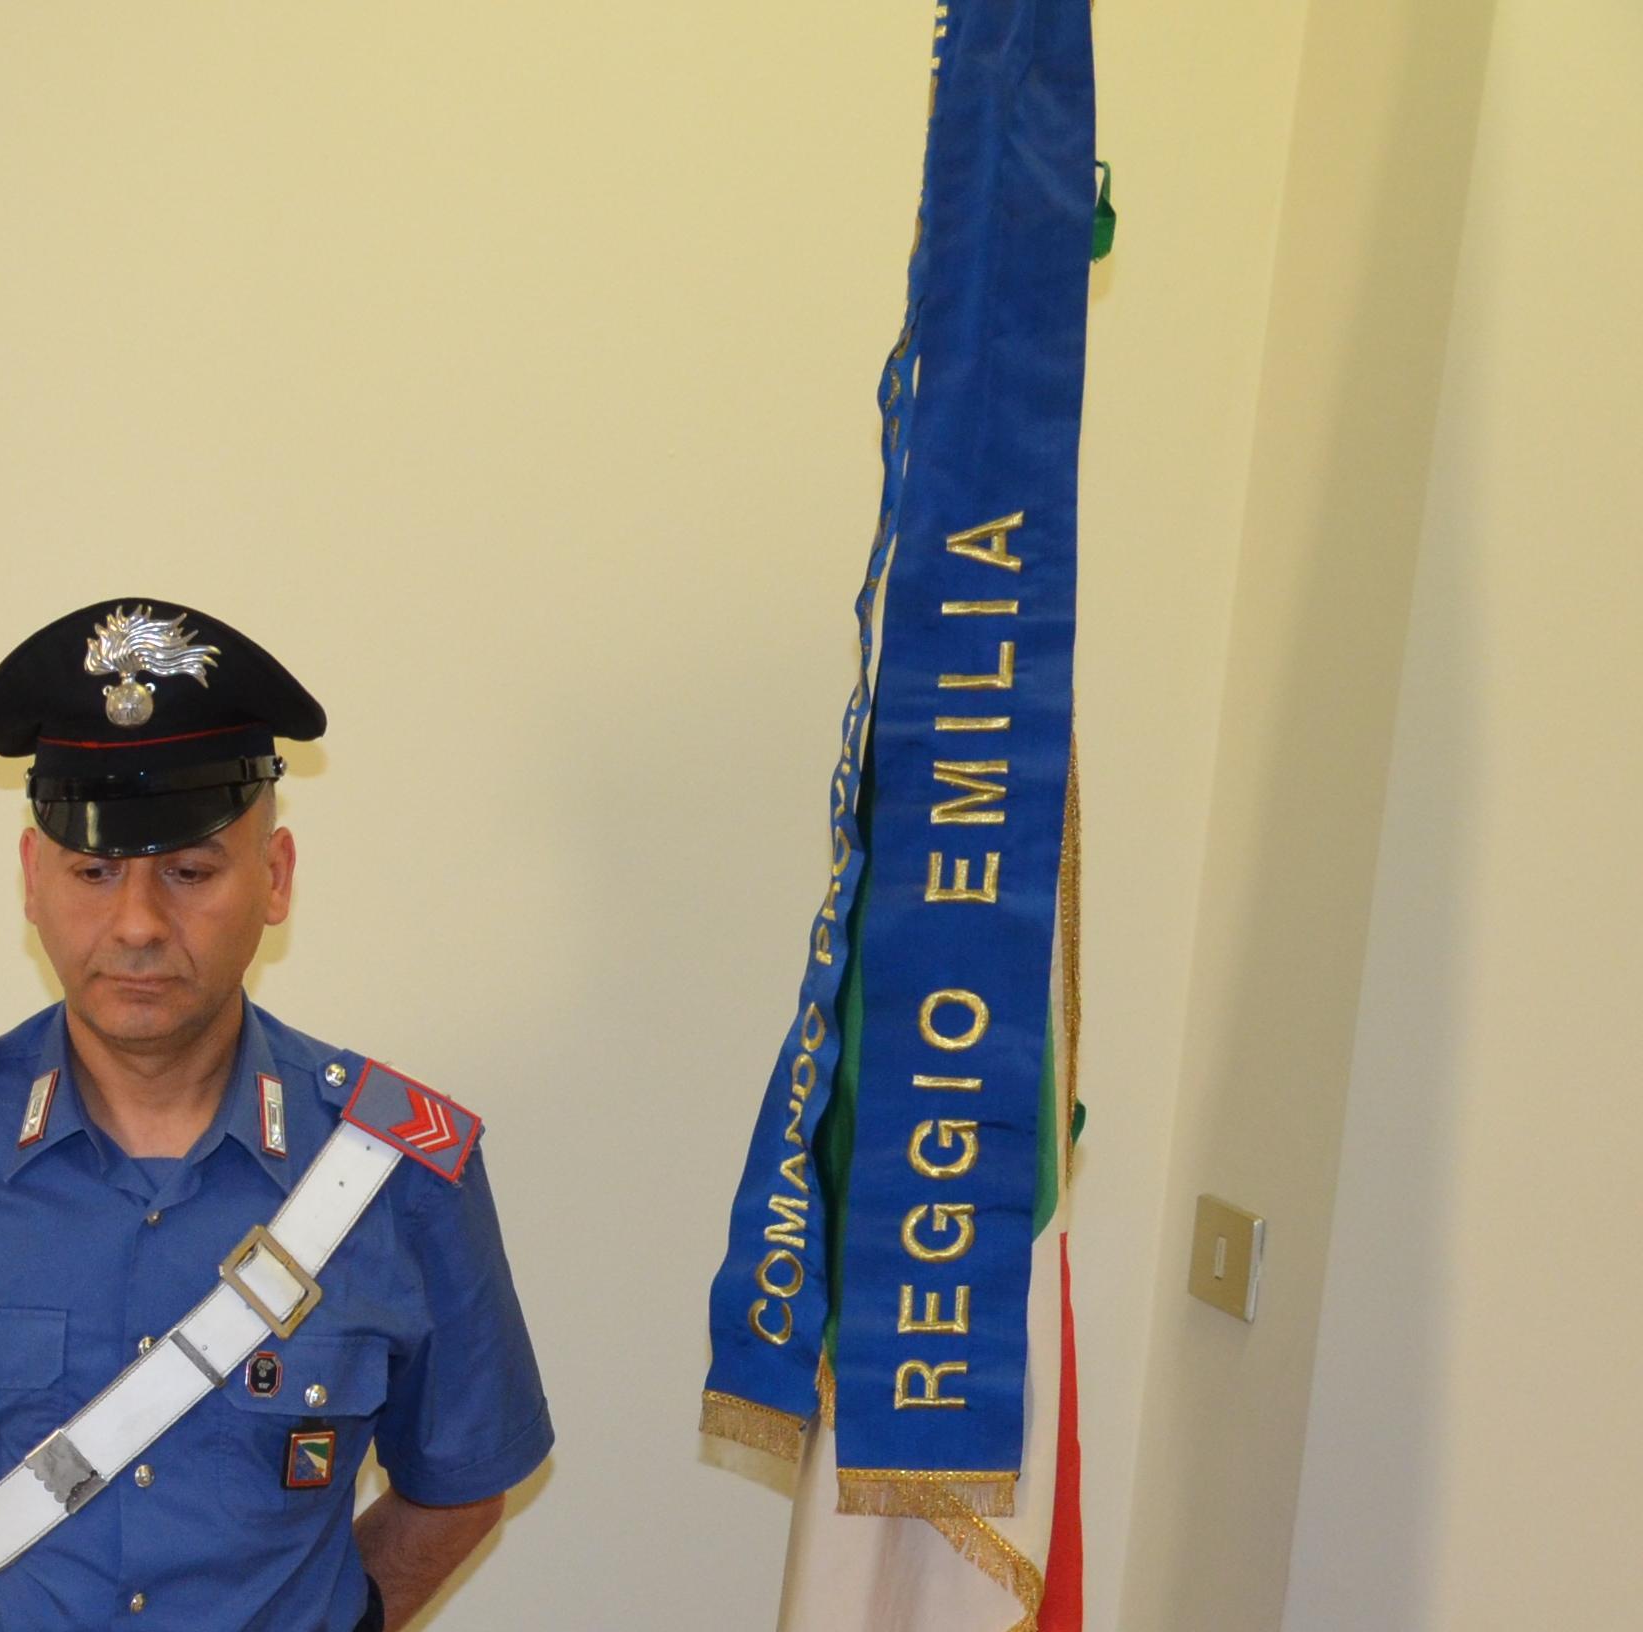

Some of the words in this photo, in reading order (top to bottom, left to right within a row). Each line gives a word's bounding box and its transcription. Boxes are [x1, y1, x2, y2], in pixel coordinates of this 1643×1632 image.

[924, 511, 1025, 903] EMILIA
[748, 1001, 827, 1346] COMANDO
[894, 988, 990, 1410] REGGIO
